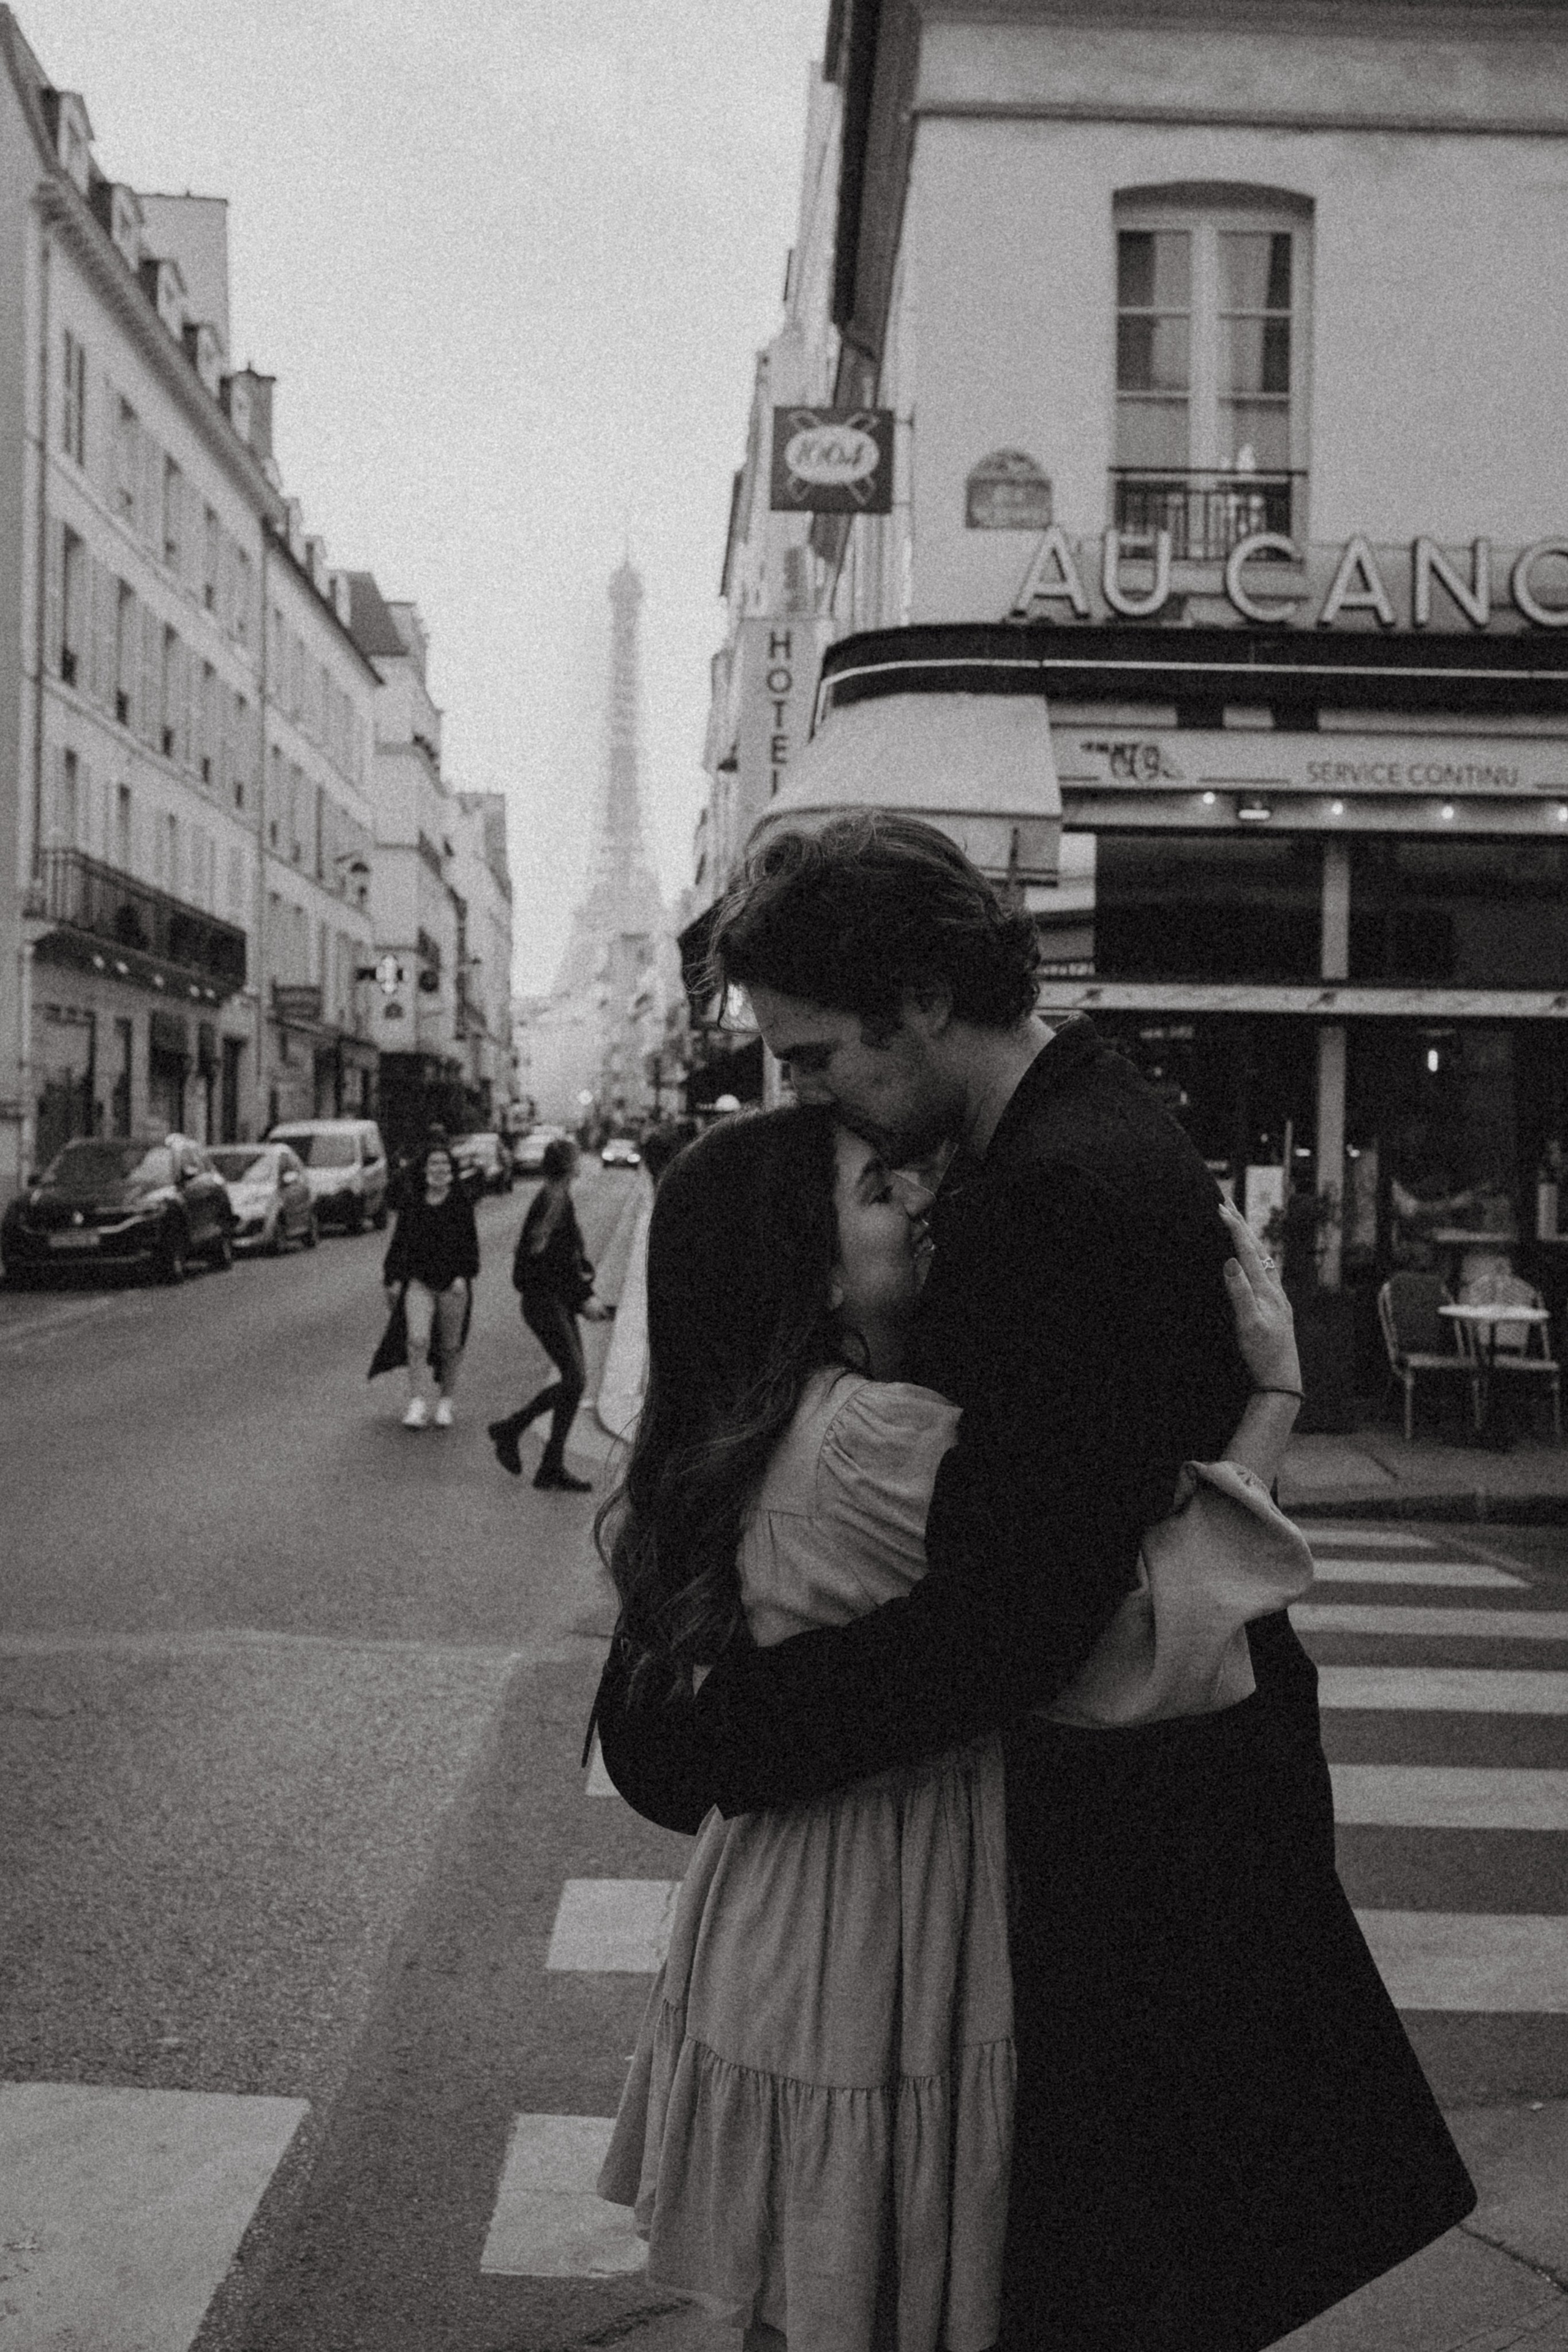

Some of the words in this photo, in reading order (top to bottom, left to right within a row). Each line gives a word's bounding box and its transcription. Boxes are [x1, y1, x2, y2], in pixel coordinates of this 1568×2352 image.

[1011, 527, 1171, 619] AU
[1306, 761, 1401, 785] SERVICE
[1407, 763, 1519, 787] CONTINU
